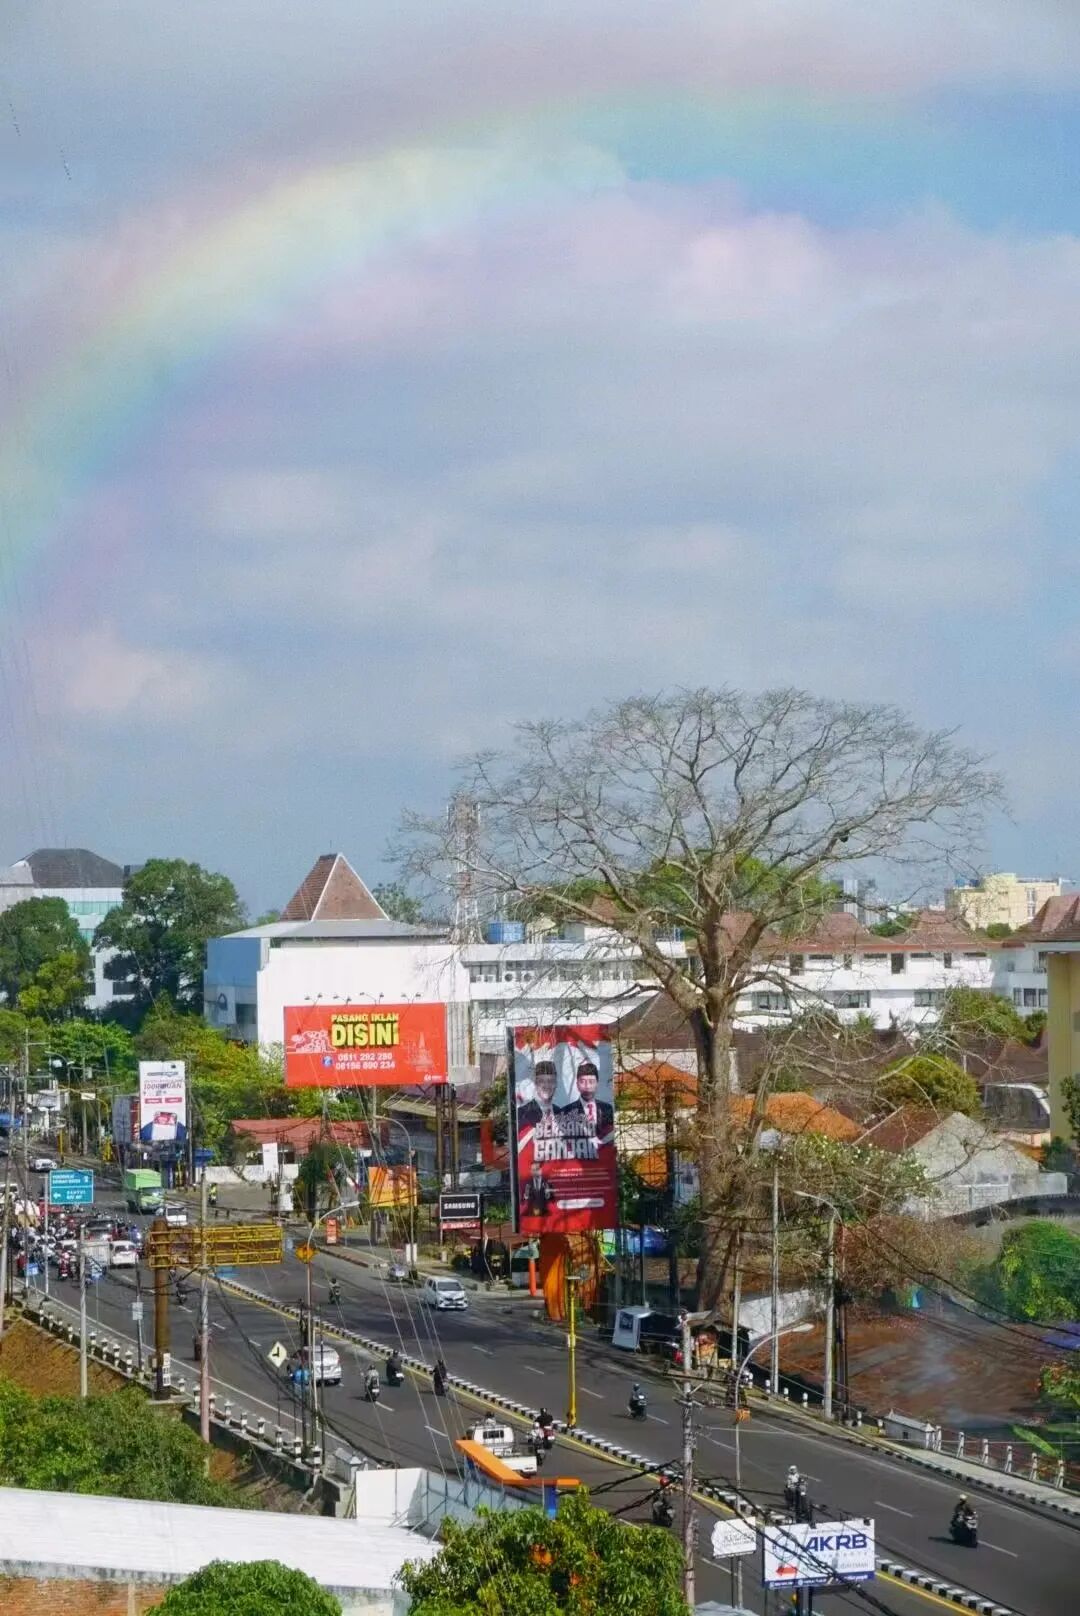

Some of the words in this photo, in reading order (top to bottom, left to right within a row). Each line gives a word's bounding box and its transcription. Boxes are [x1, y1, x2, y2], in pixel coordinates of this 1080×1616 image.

[331, 1013, 369, 1023] PASANG
[371, 1012, 399, 1022] IKLAN
[331, 1023, 399, 1047] DISINI
[535, 1121, 597, 1138] BERSAMA
[533, 1138, 599, 1161] GANJAR
[805, 1534, 868, 1552] AKRB
